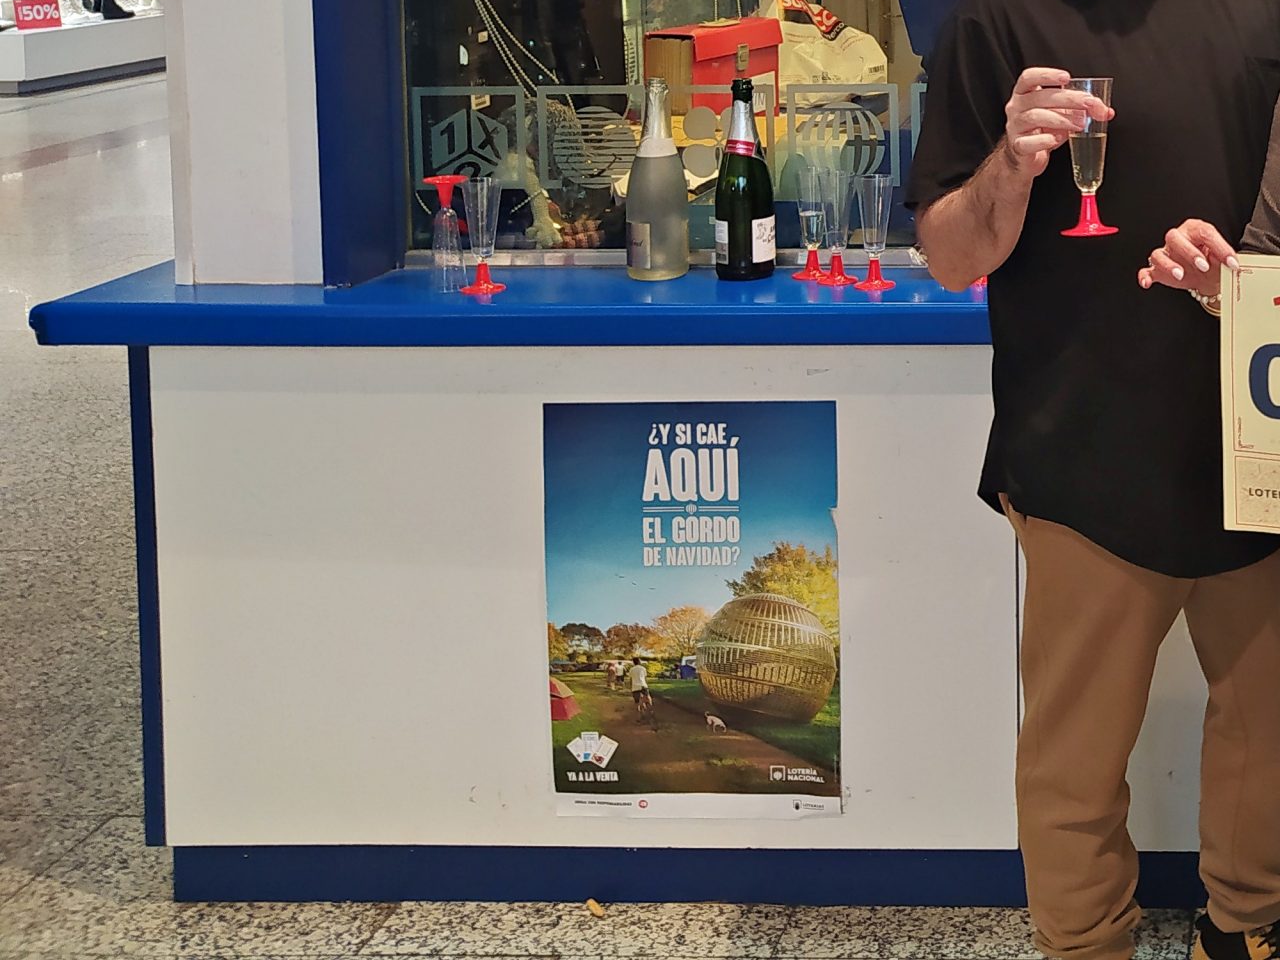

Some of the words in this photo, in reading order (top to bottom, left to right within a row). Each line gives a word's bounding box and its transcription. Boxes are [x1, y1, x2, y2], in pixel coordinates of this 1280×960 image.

[649, 423, 670, 445] ¿Y
[675, 424, 691, 445] SI
[696, 423, 727, 445] CAE
[642, 437, 740, 502] AQUÍ
[643, 516, 666, 544] EL
[672, 515, 740, 543] GORDO
[644, 547, 662, 567] DE
[666, 546, 740, 567] NAVIDAD?
[566, 771, 577, 781] YA
[579, 771, 584, 781] A
[585, 771, 594, 781] LA
[788, 775, 825, 783] NACIONAL
